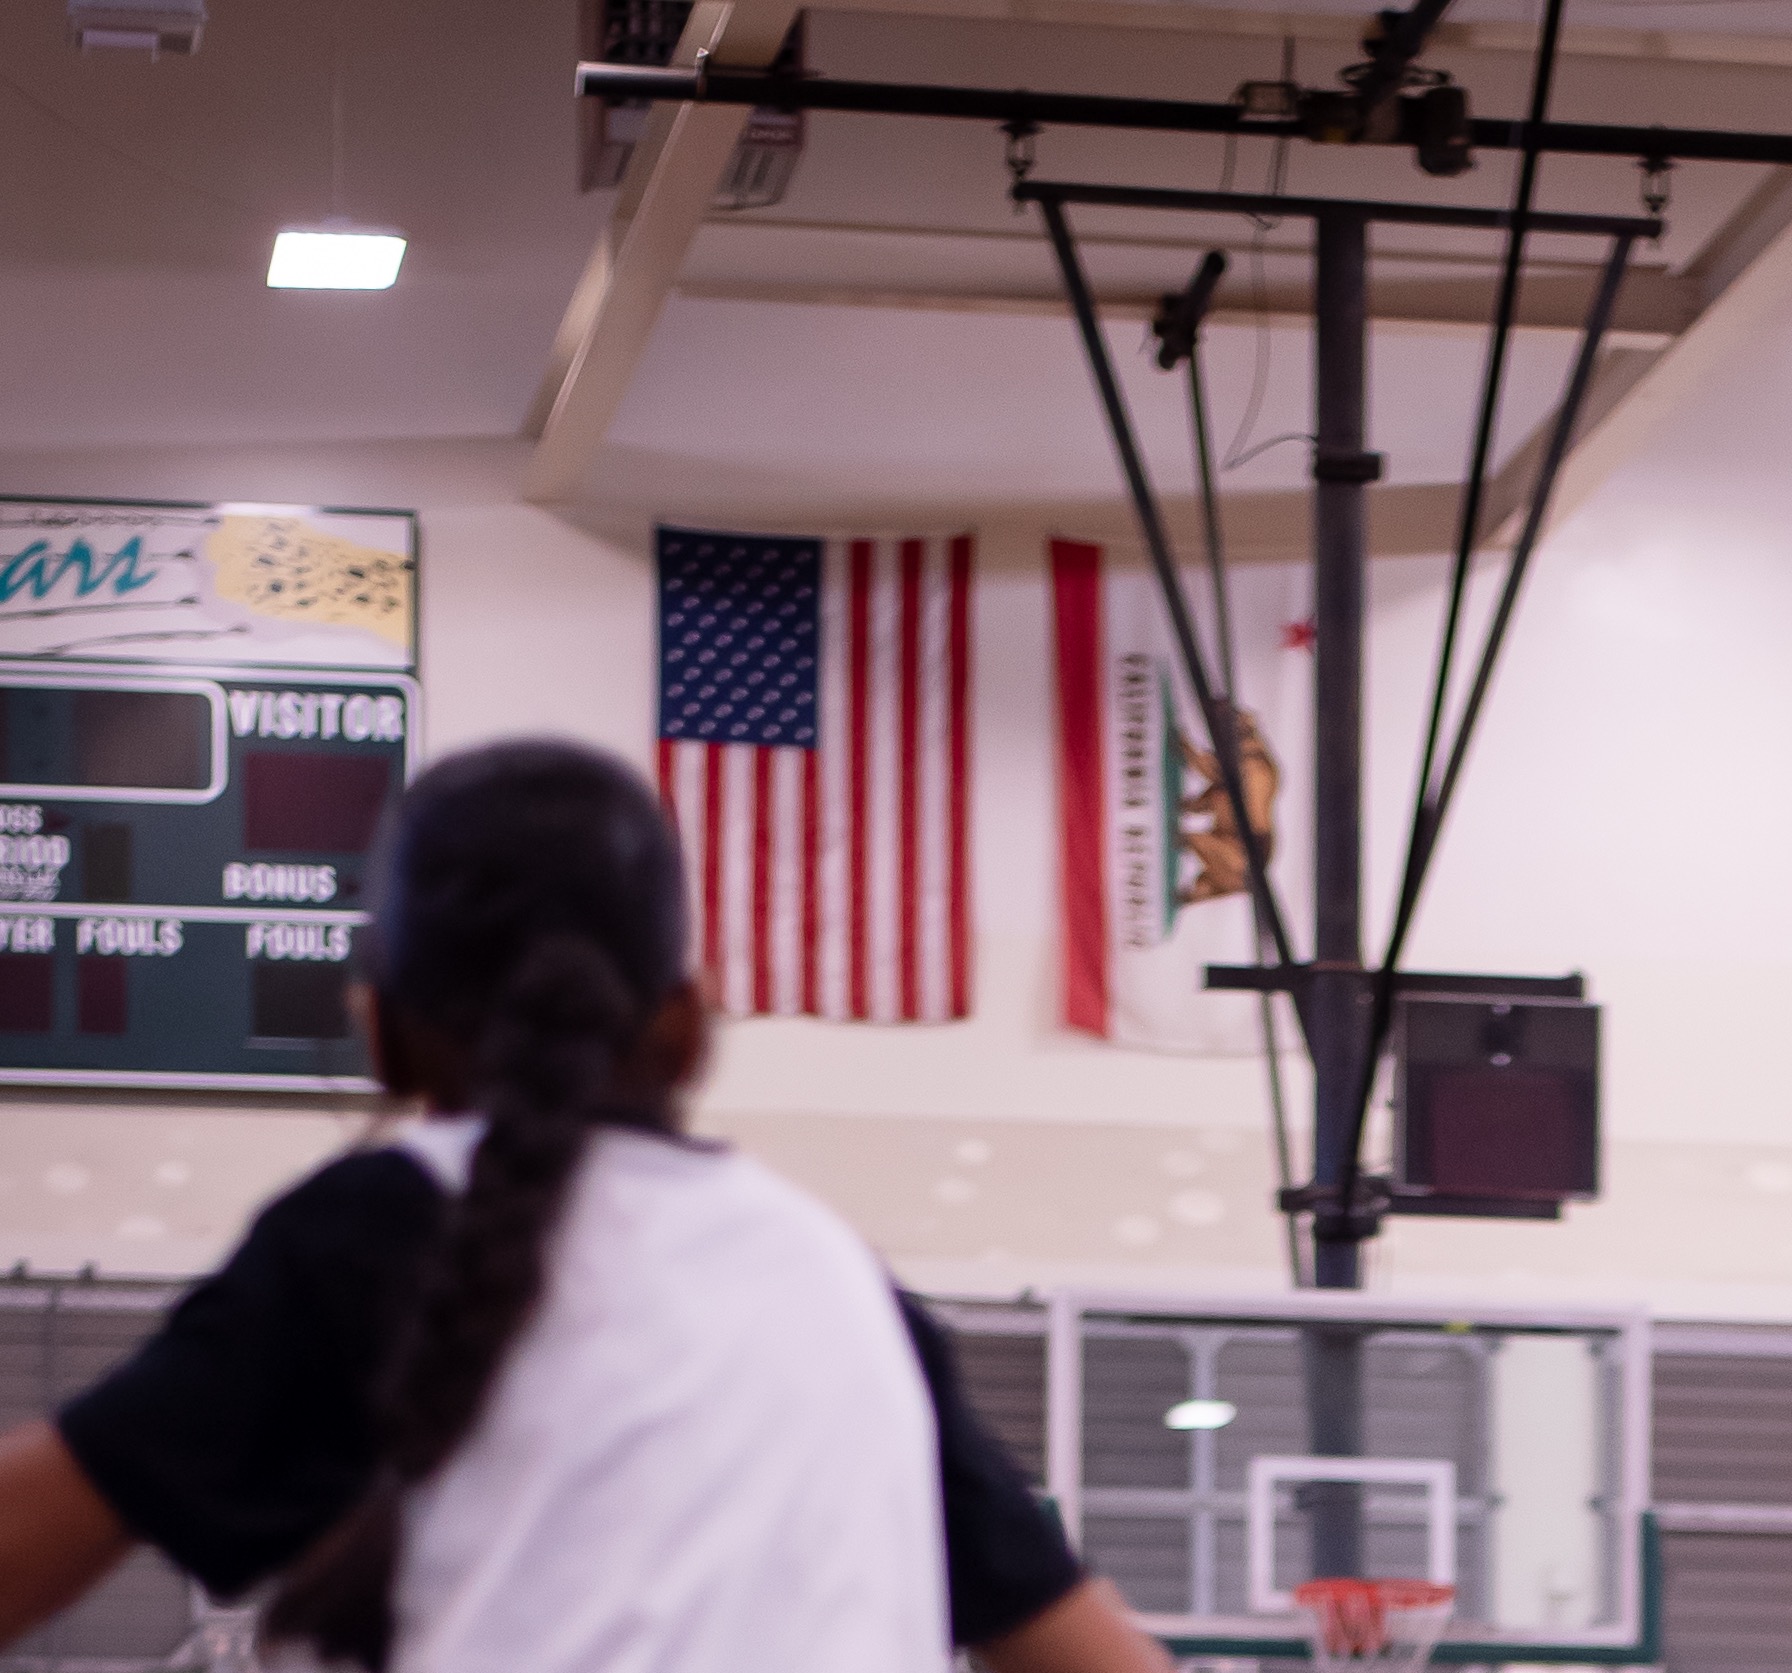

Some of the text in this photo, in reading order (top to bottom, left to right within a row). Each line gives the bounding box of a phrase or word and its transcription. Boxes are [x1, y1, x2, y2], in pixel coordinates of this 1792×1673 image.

[229, 690, 405, 742] VISITOR
[222, 861, 337, 902] BONUS
[76, 917, 184, 957] FOULS
[246, 925, 351, 962] FOULS
